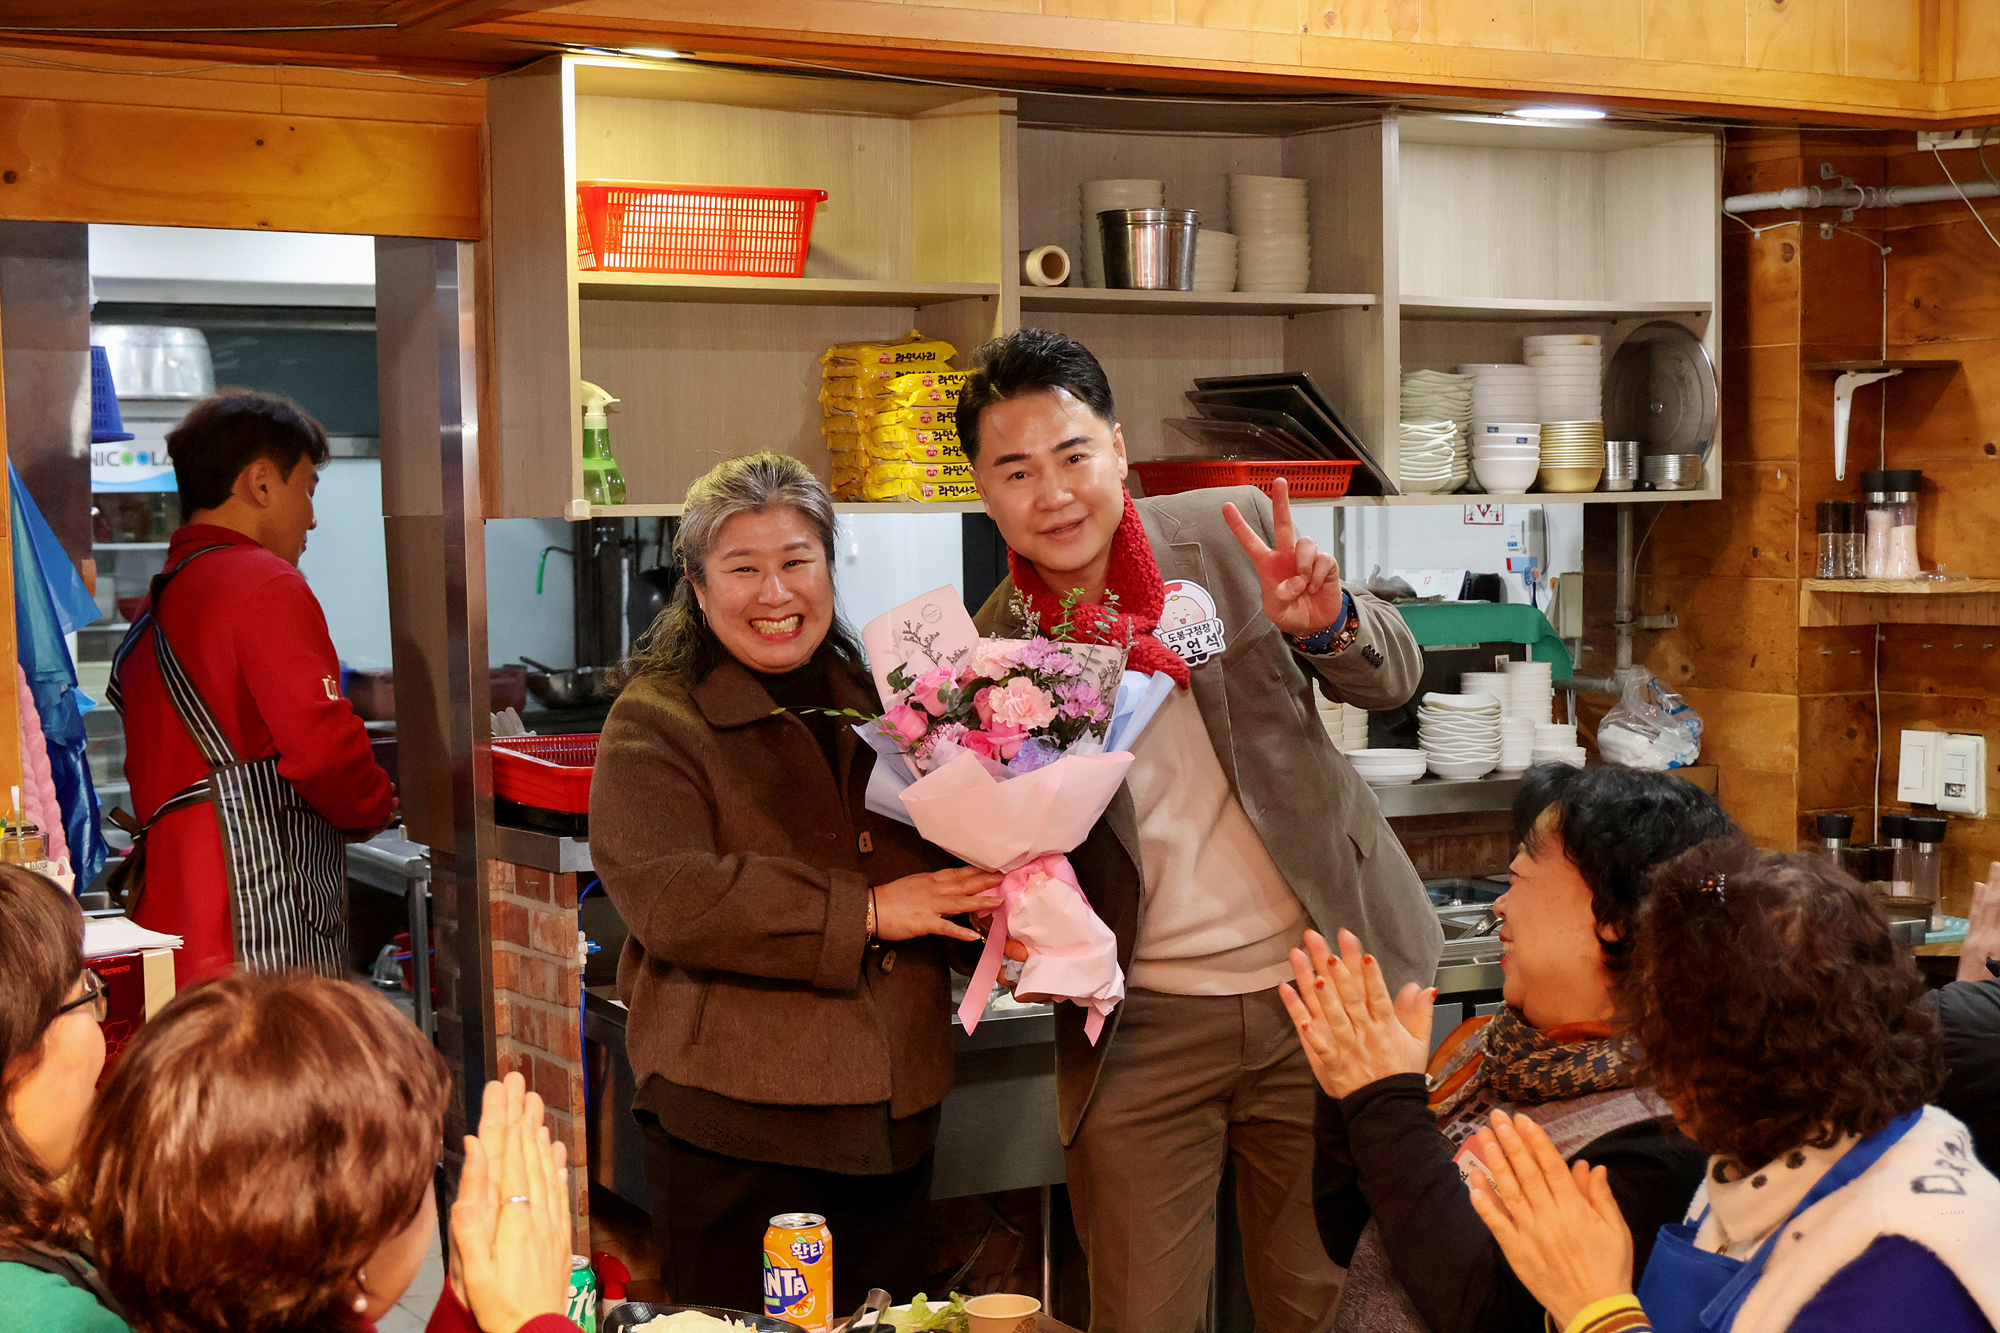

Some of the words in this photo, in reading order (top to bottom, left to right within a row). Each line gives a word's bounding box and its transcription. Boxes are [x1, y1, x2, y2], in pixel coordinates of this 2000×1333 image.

[895, 351, 936, 363] 라면사리
[1167, 622, 1211, 643] 도봉구청장
[790, 1239, 825, 1260] 환타
